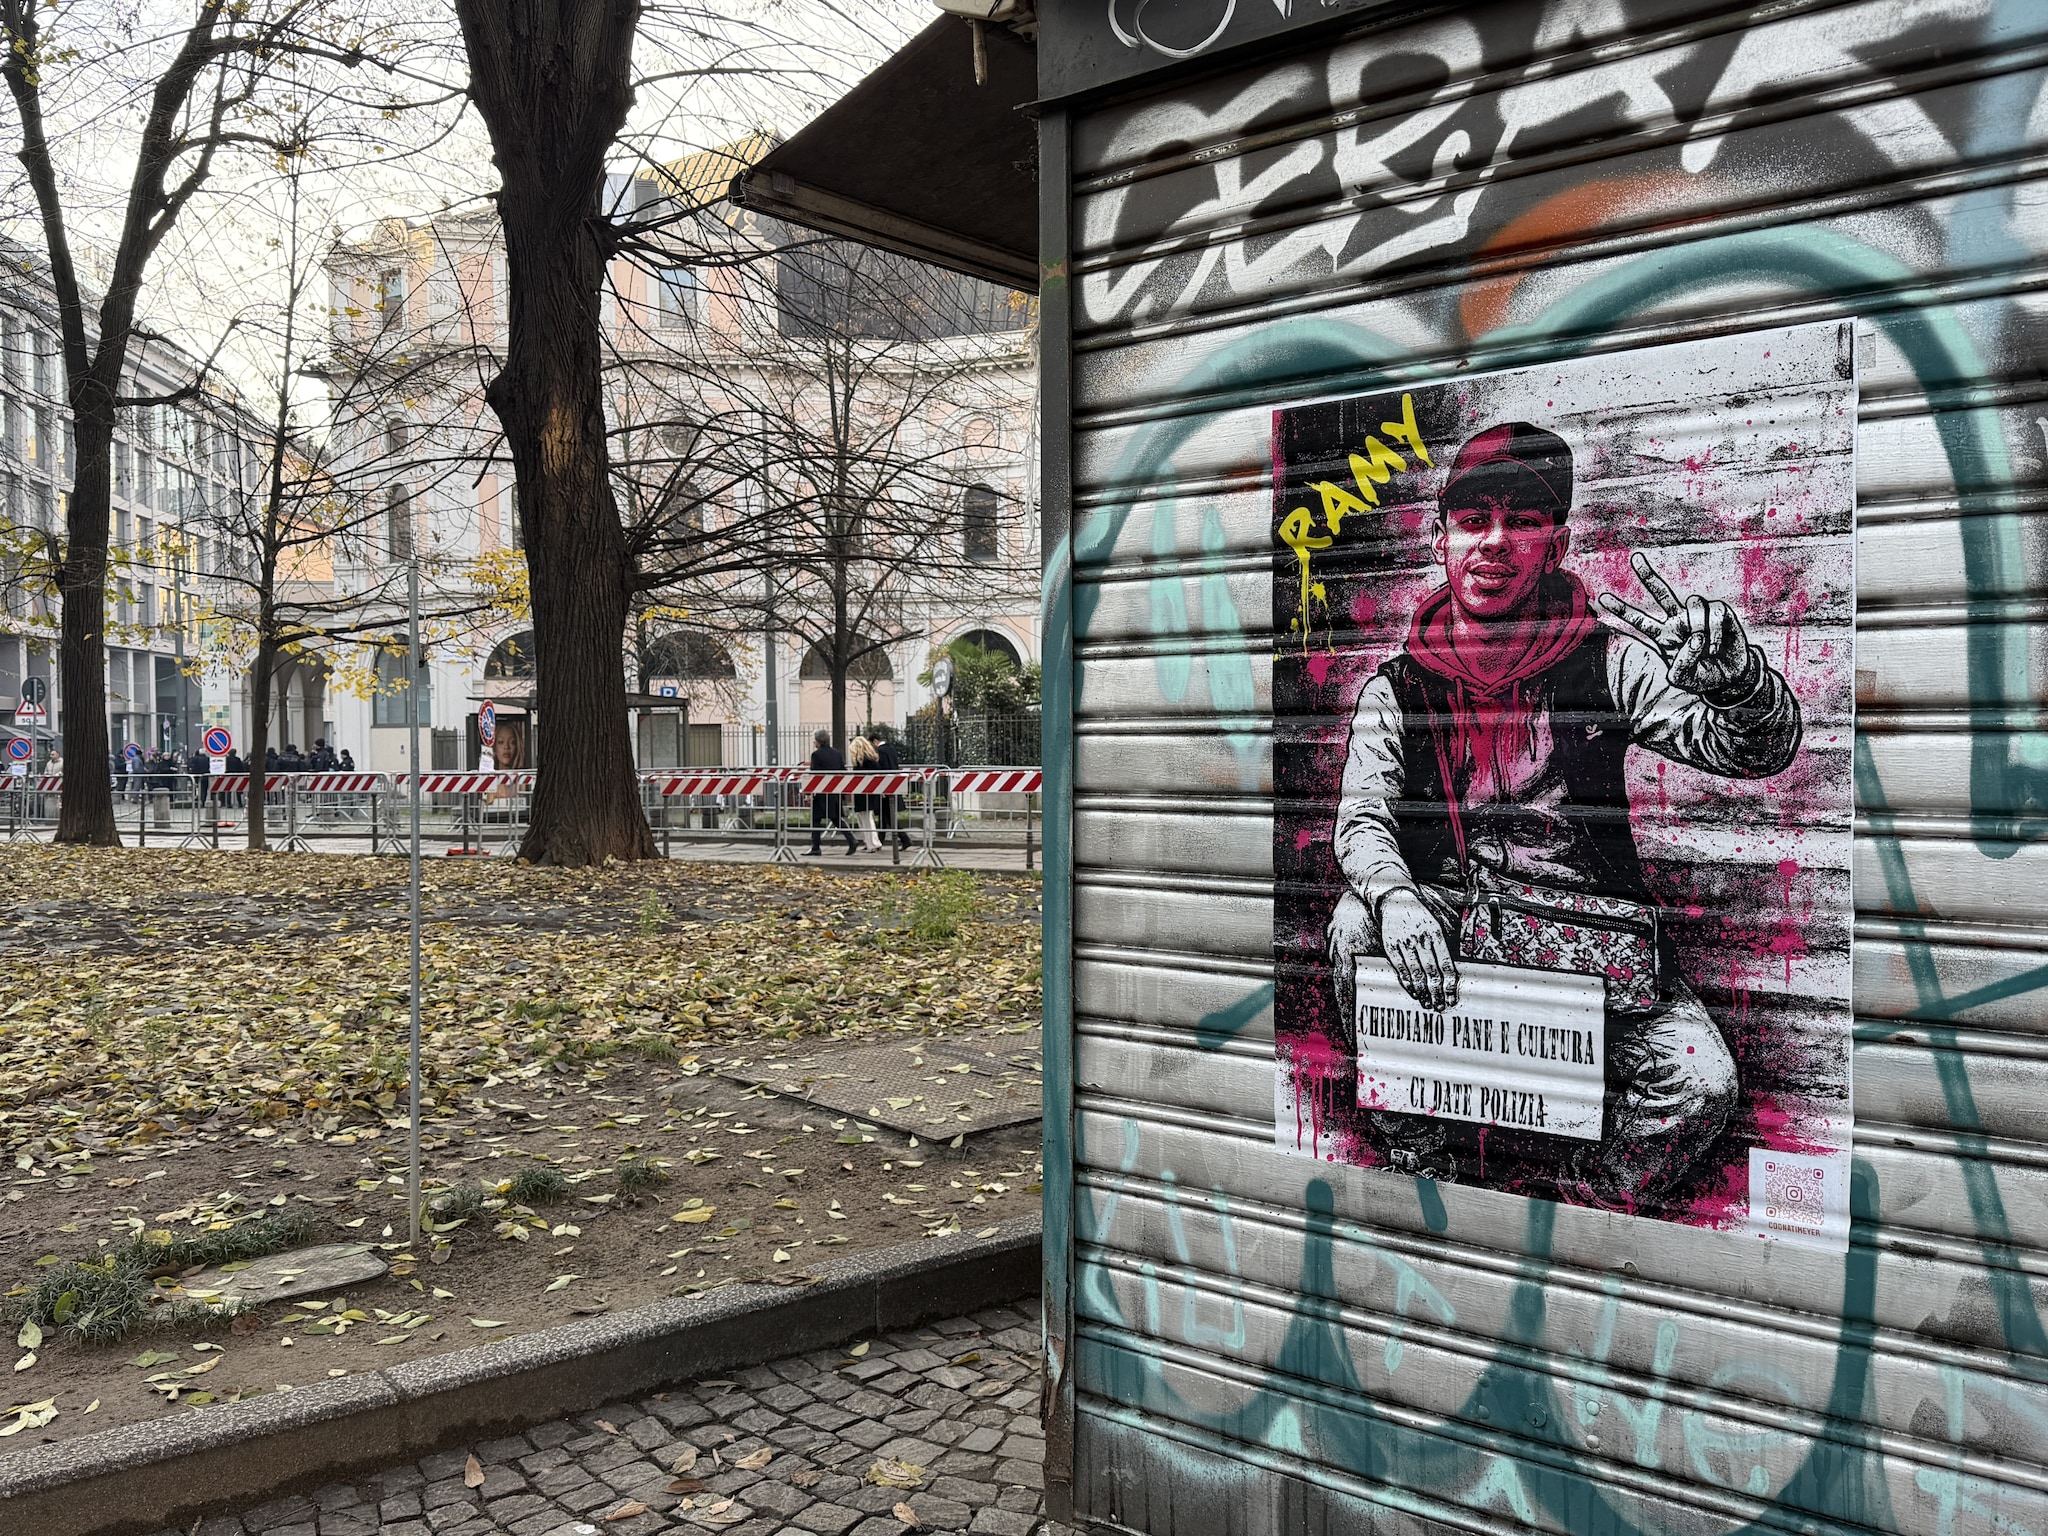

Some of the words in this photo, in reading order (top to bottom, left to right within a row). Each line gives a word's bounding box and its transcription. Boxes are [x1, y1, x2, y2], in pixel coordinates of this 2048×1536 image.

[1278, 393, 1435, 560] RAMY
[1360, 1004, 1445, 1046] CHIEDIAMO
[1452, 1016, 1494, 1052] PANE
[1501, 1020, 1510, 1054] E
[1517, 1023, 1595, 1065] CULTURA
[1410, 1076, 1425, 1108] CI
[1433, 1080, 1472, 1116] DATE
[1480, 1086, 1546, 1127] POLIZIA
